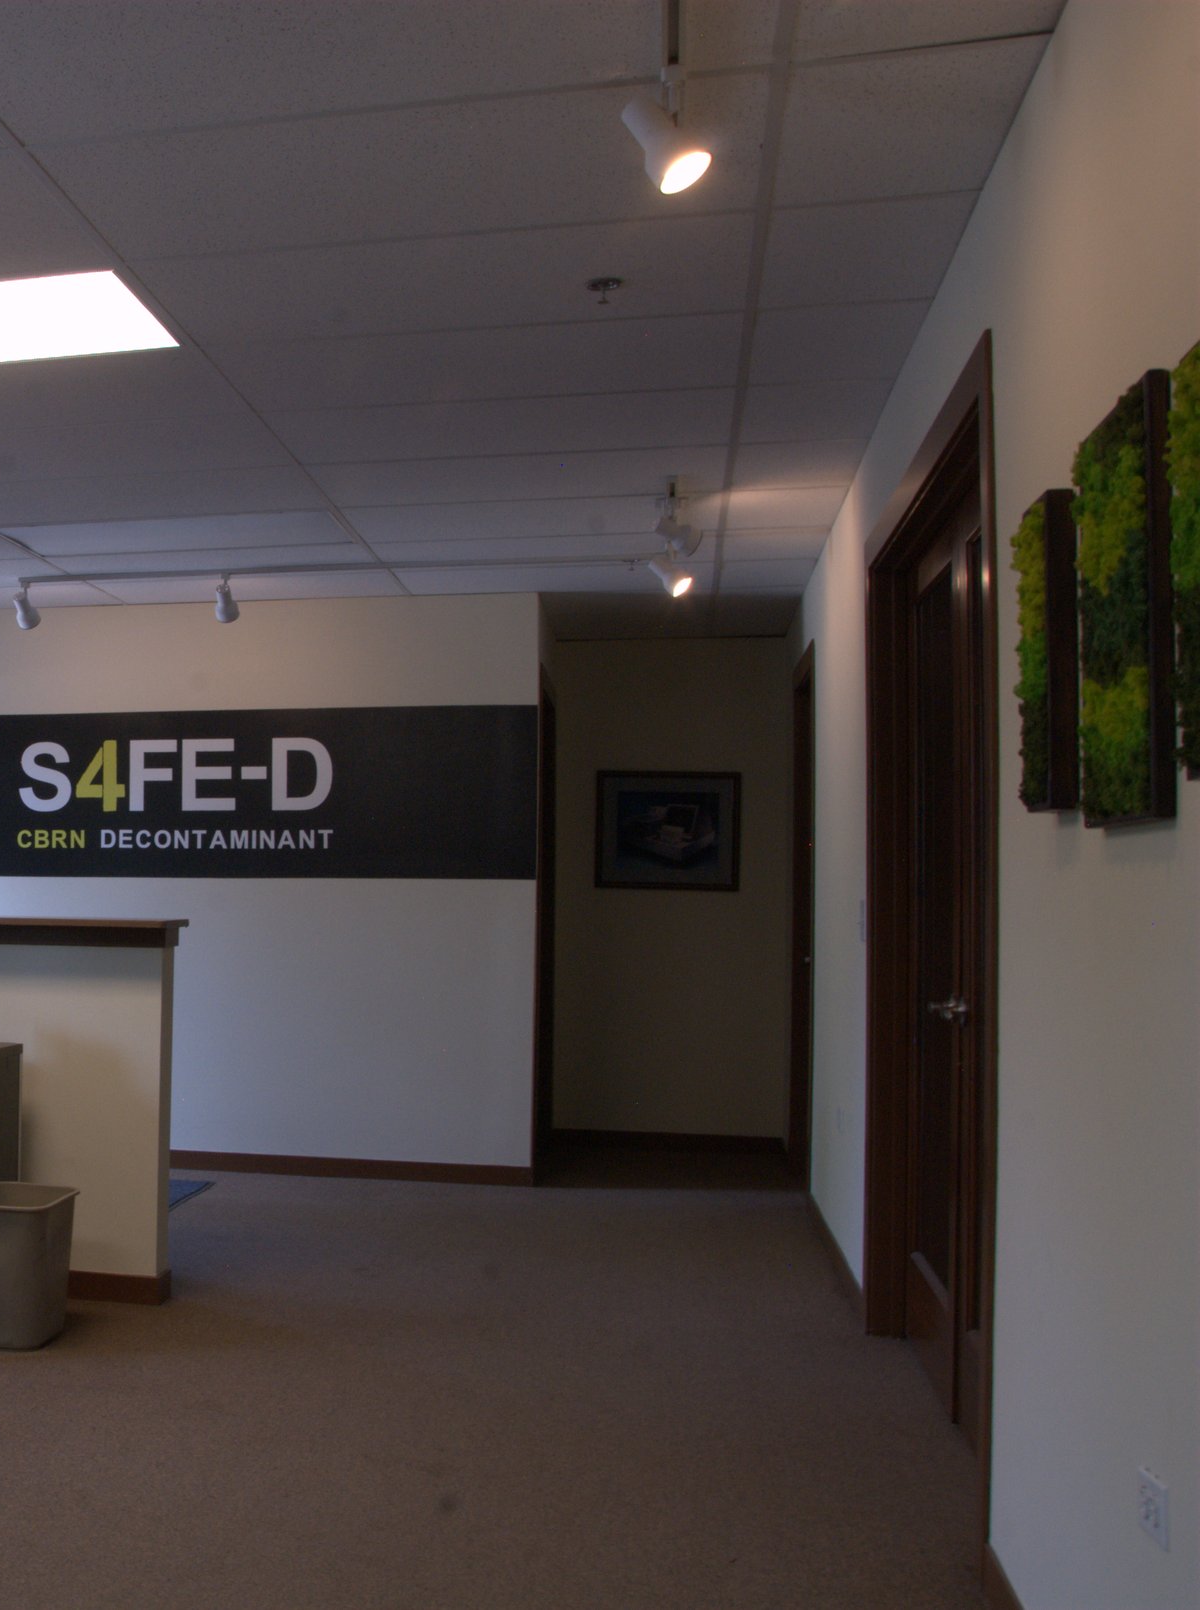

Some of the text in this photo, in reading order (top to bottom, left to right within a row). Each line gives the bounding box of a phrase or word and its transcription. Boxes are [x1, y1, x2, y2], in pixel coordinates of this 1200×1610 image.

[18, 737, 334, 813] S4FE-D
[16, 829, 334, 849] CBRN DECONTAMINANT
